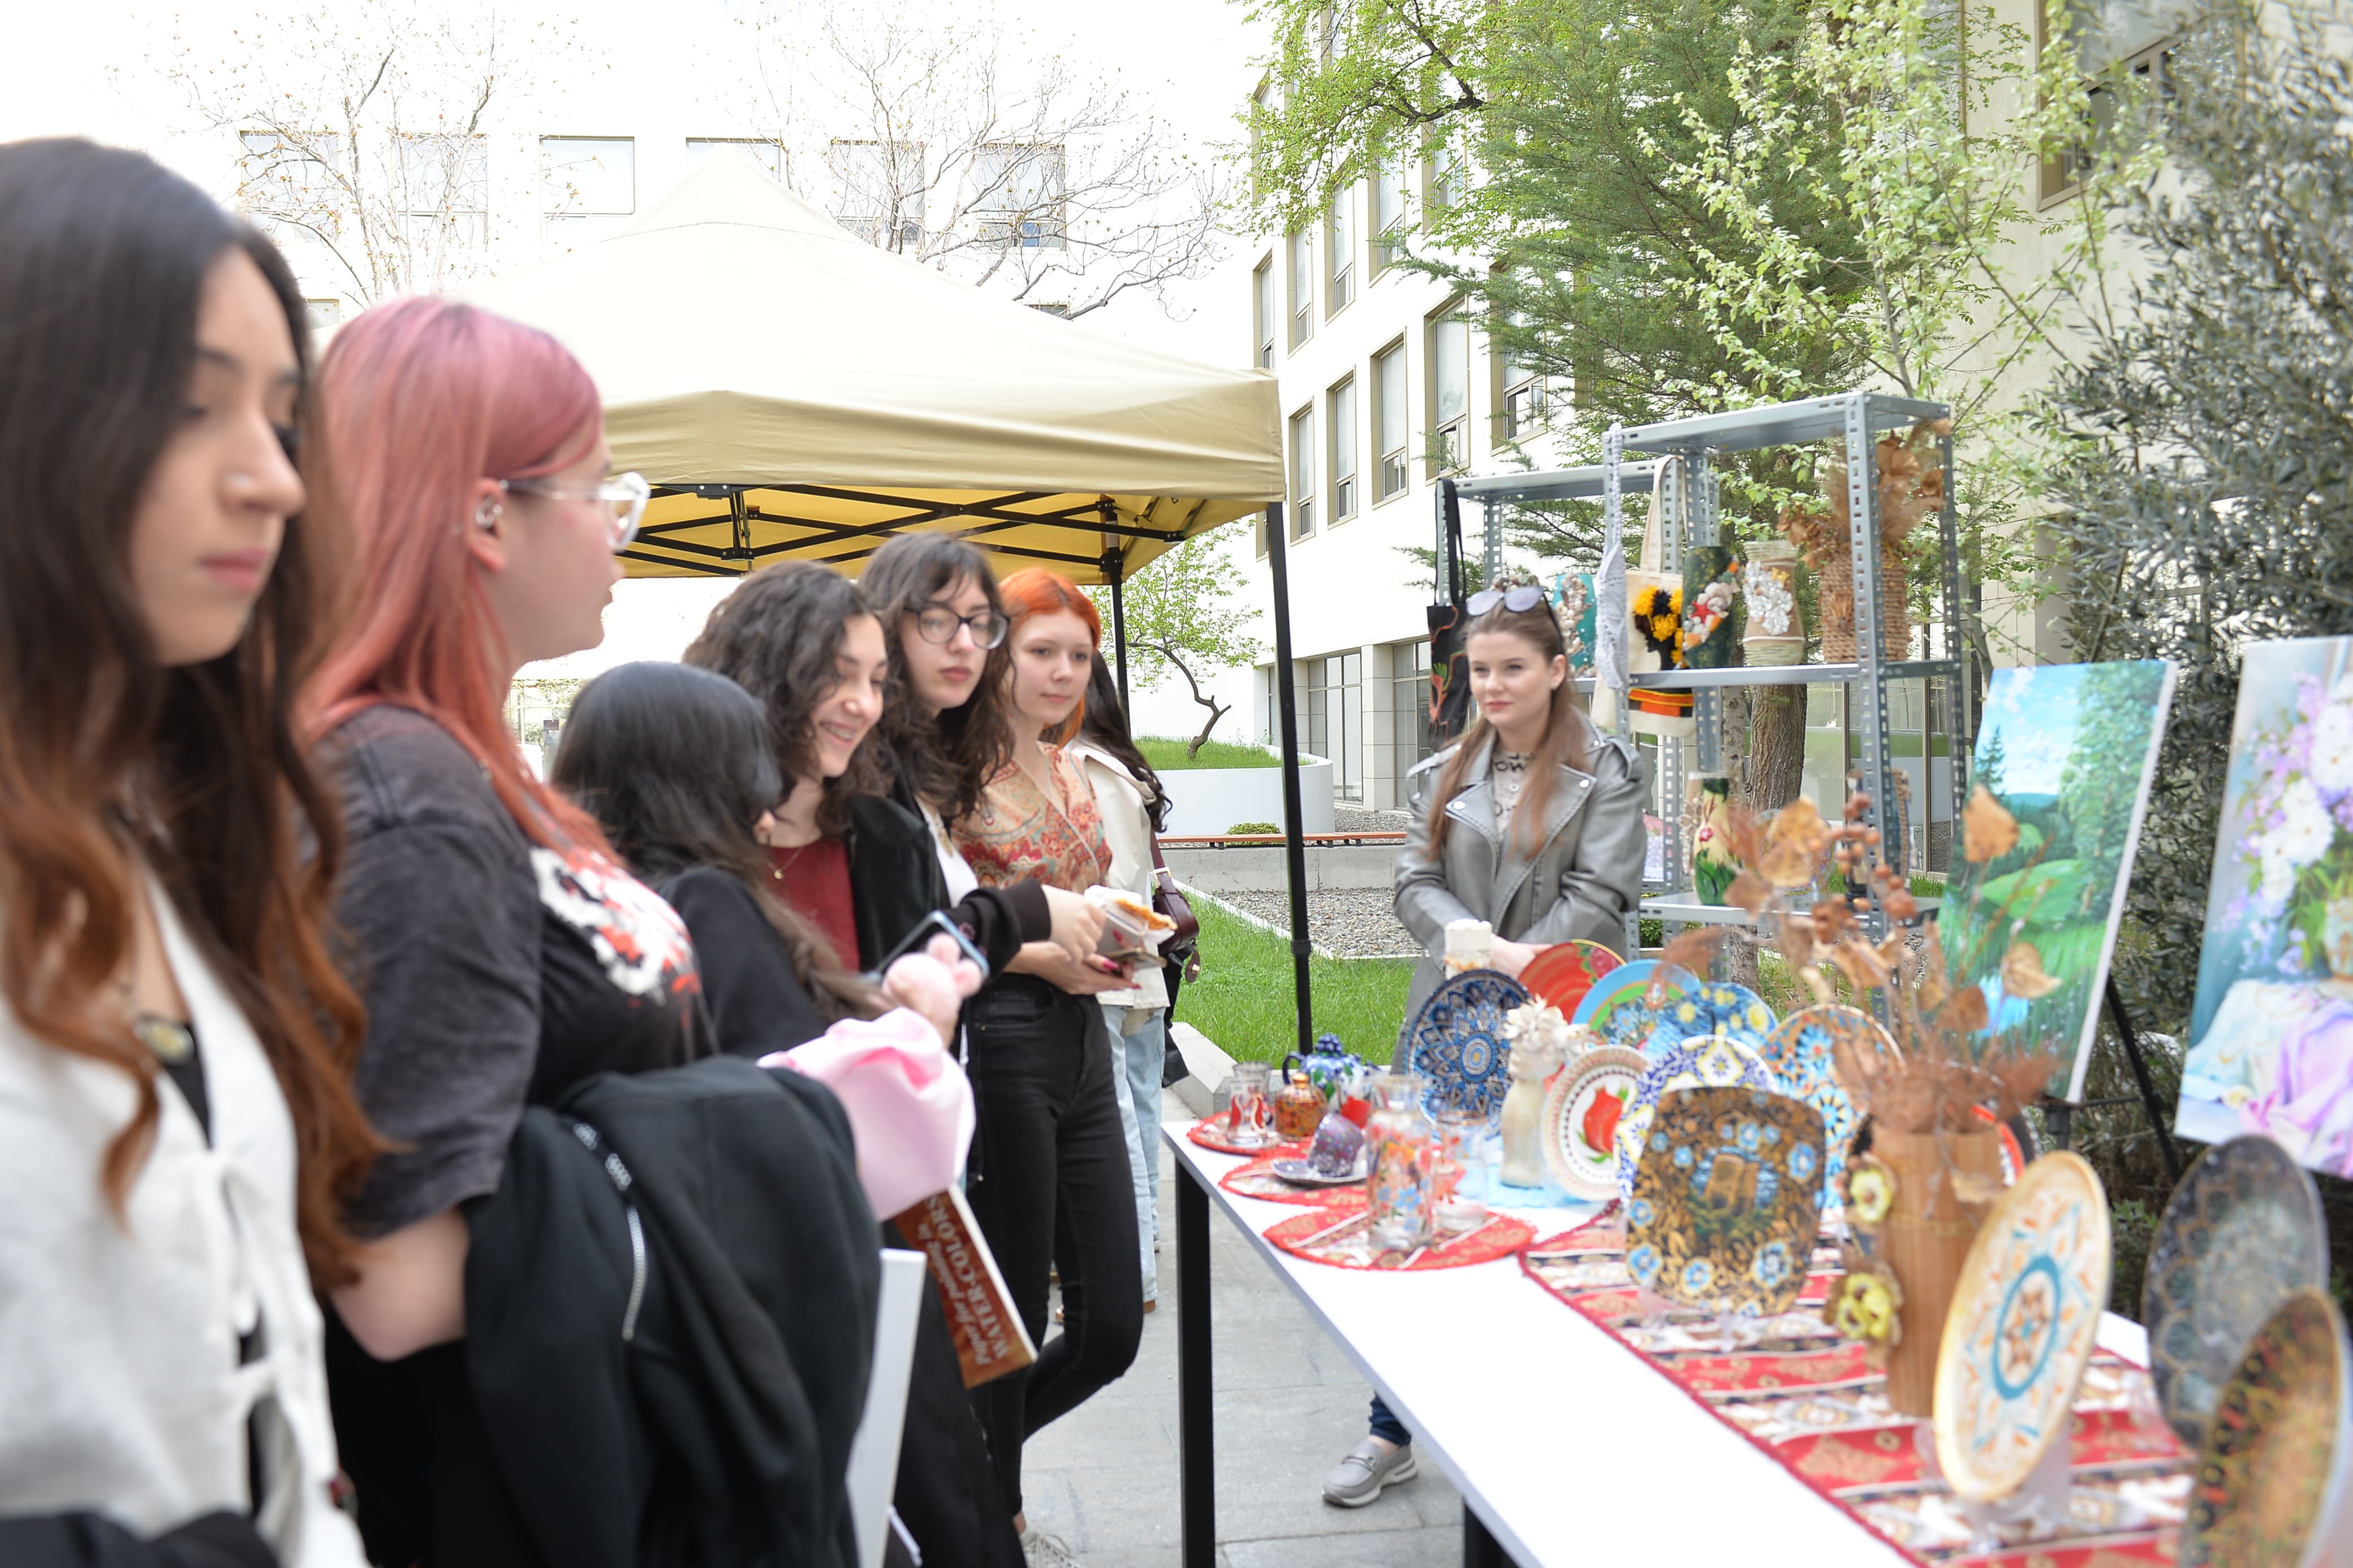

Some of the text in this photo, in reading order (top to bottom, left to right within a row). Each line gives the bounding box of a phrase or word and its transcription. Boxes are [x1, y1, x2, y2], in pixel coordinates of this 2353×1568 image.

[917, 1223, 993, 1365] Paper for painting in
[925, 1196, 1009, 1360] WATER-COLORS
